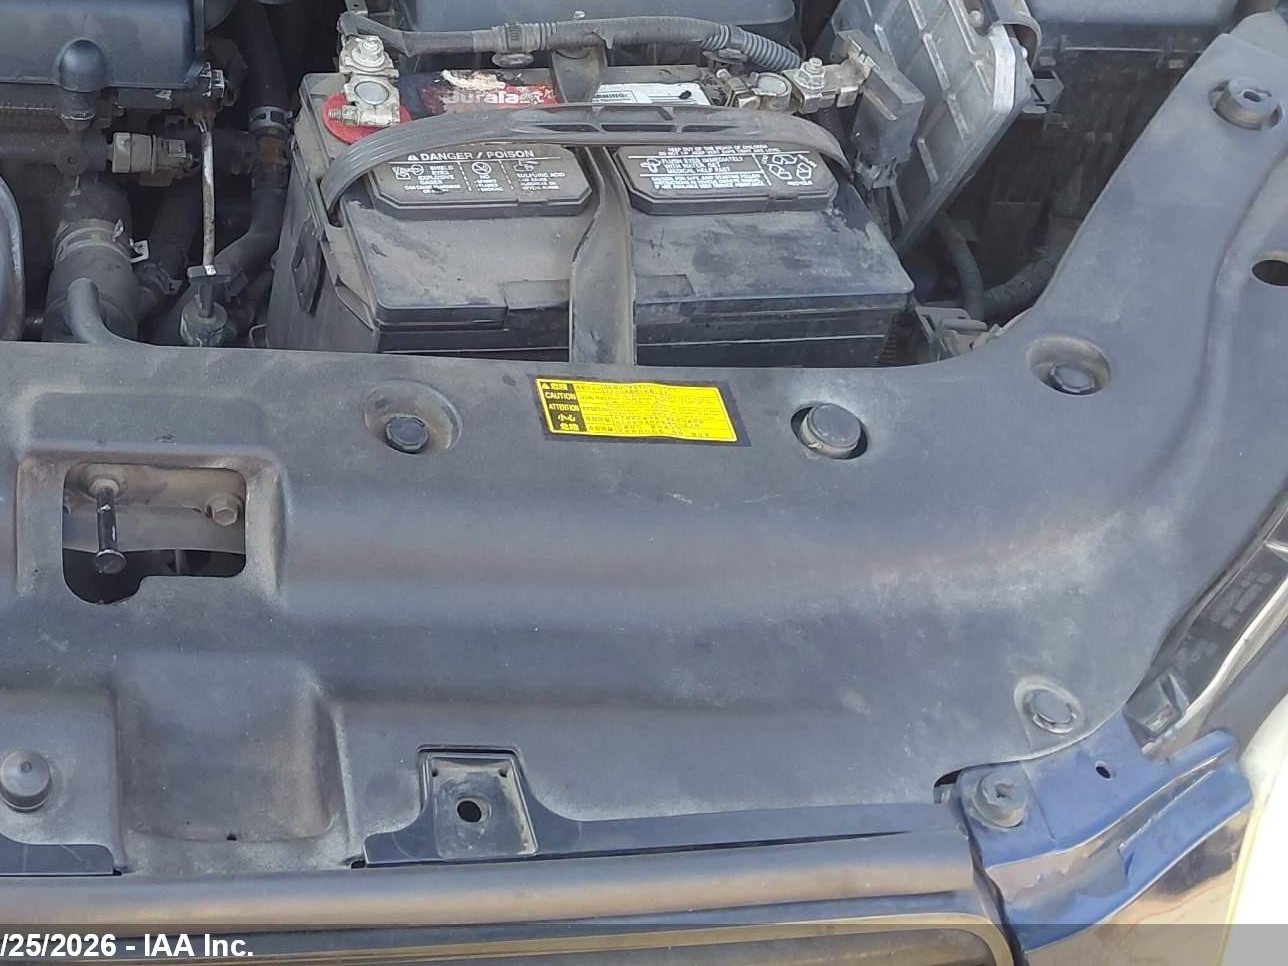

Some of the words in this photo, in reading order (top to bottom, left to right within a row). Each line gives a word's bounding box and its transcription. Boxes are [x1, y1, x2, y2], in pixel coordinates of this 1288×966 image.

[420, 152, 474, 161] DANGER
[486, 149, 535, 159] POISON
[545, 391, 577, 400] CAUTION
[548, 403, 580, 411] ATTENTION
